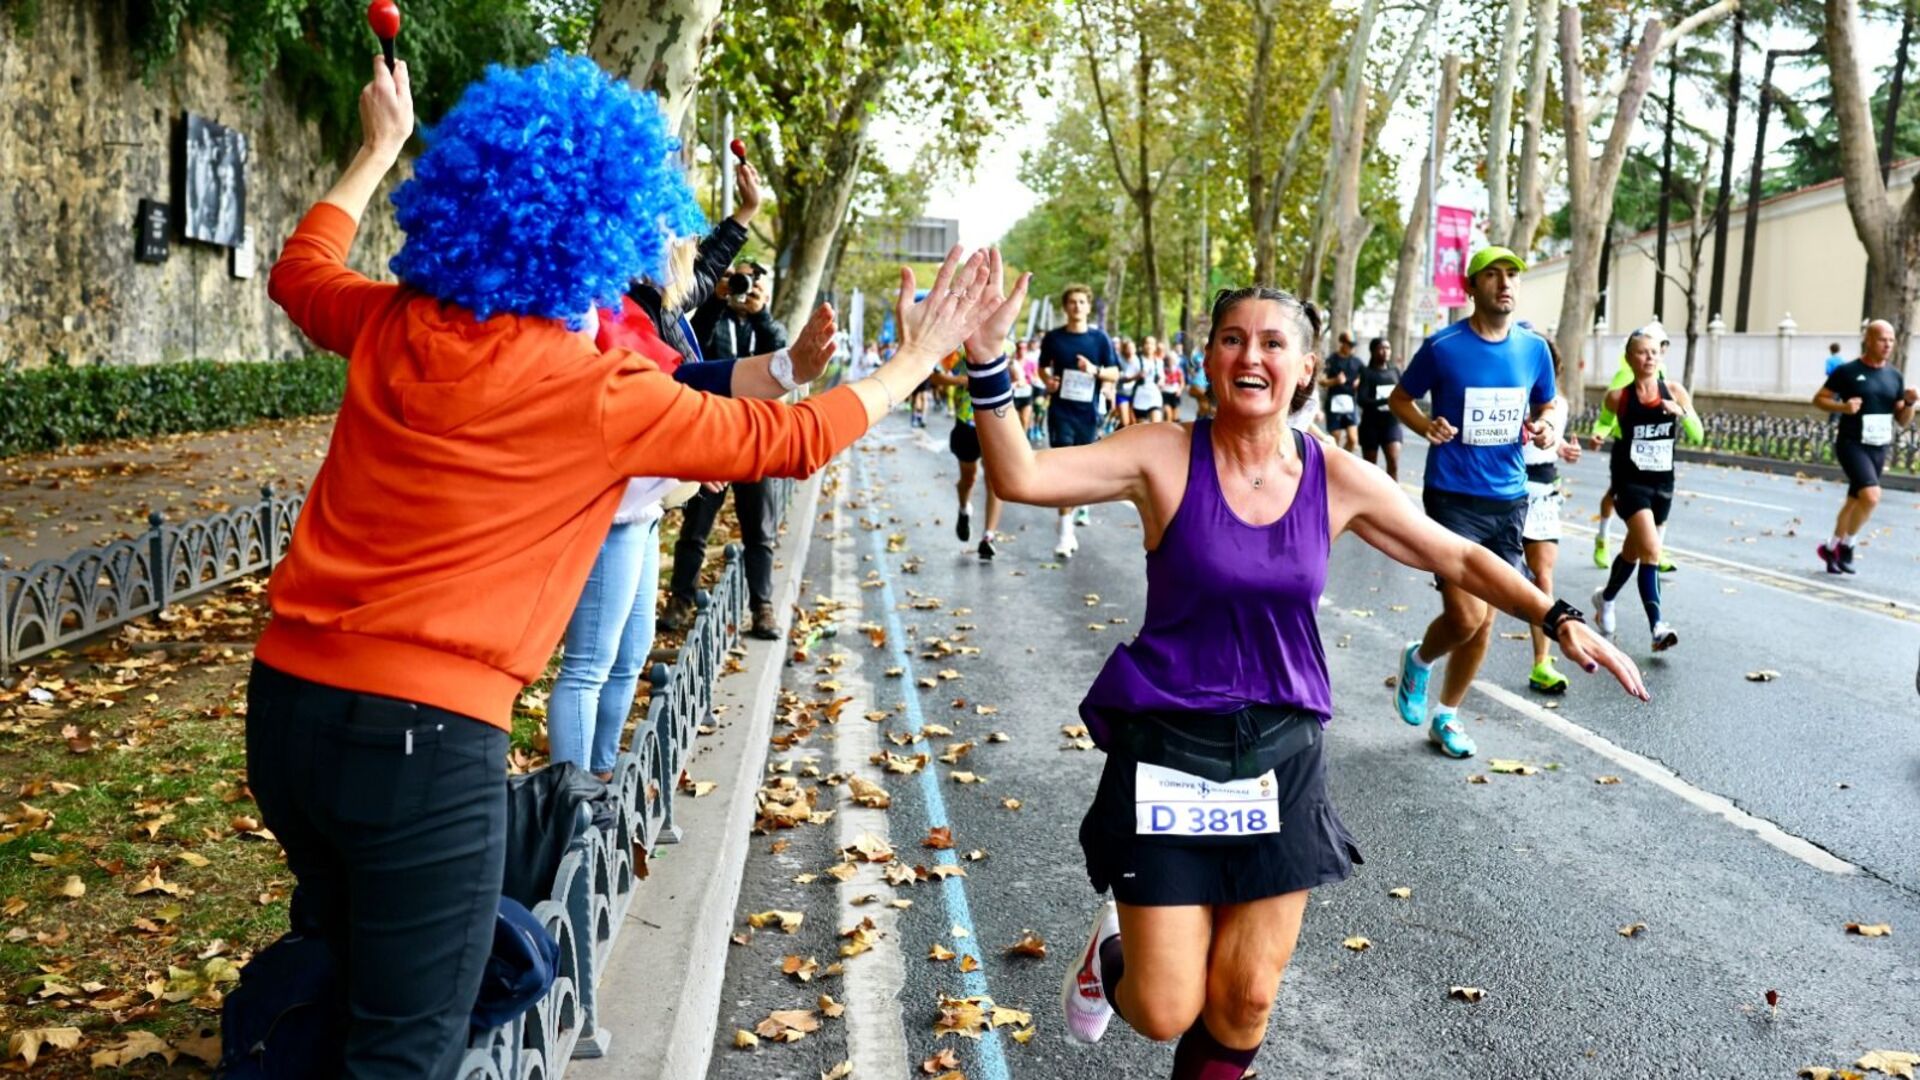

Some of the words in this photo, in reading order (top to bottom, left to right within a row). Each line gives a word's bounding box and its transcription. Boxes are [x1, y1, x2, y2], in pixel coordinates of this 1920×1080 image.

[1472, 409, 1484, 422] D
[1489, 408, 1519, 422] 4512
[1633, 422, 1673, 438] BEAT
[1151, 805, 1176, 831] D
[1187, 807, 1268, 833] 3818
